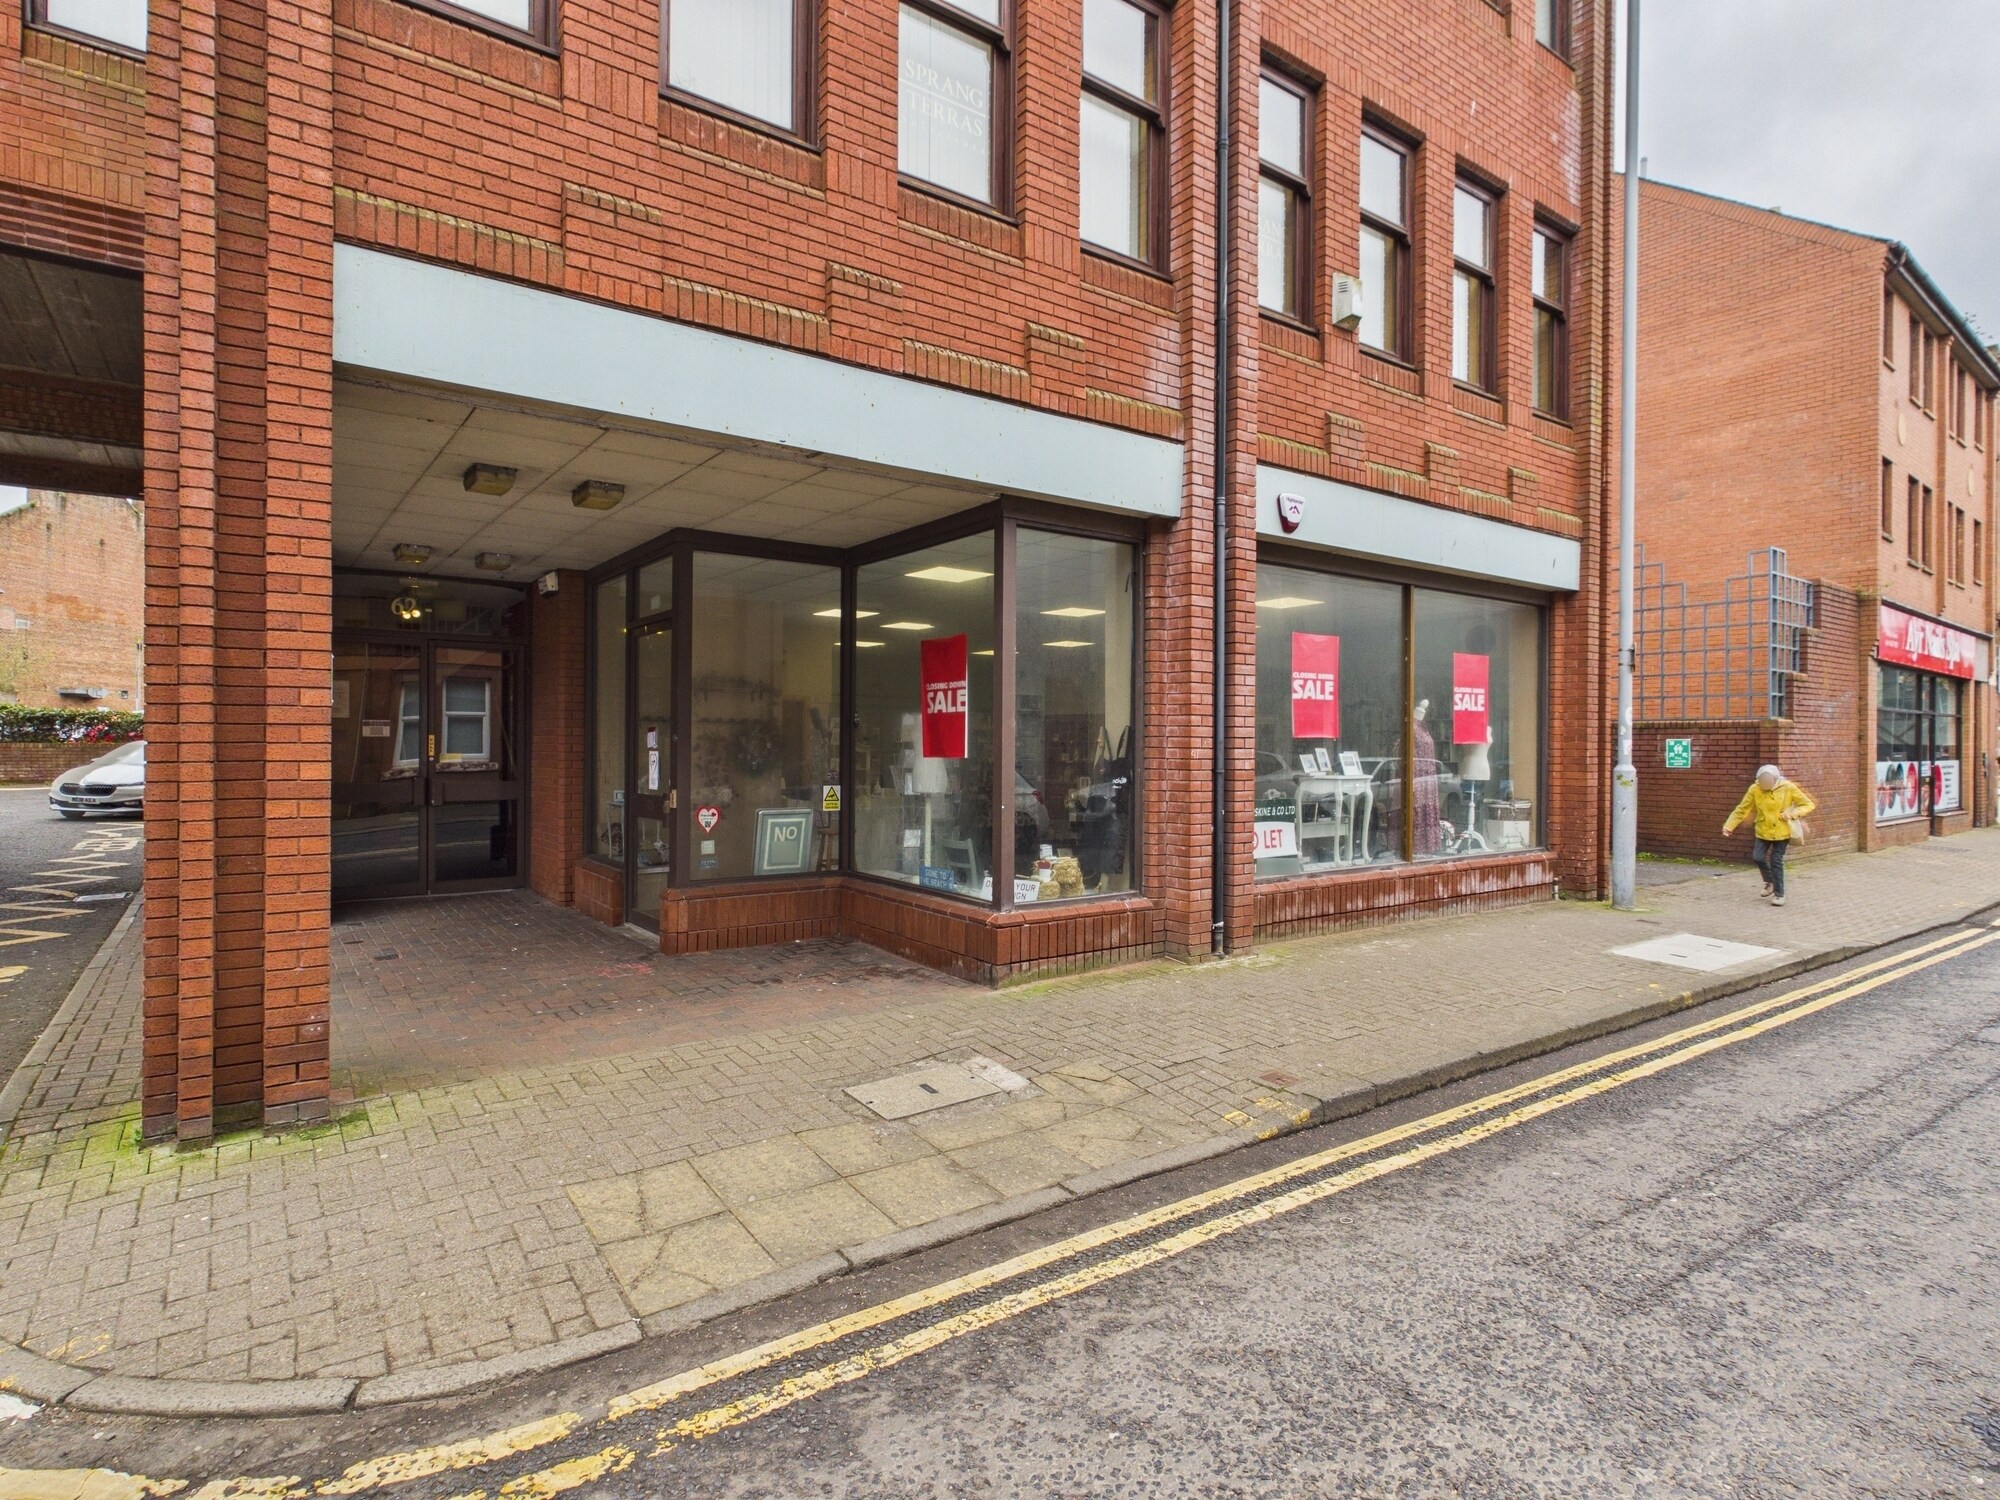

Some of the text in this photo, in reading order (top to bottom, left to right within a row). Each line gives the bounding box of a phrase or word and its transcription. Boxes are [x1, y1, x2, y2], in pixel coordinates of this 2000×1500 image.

[905, 58, 983, 109] SPRANG
[906, 87, 982, 137] TERRAS
[1905, 618, 1923, 662] Ayr
[1923, 622, 1946, 660] Nails
[1292, 671, 1317, 679] CLOSING
[926, 680, 966, 690] CLOSING DOWN
[1292, 680, 1334, 700] SALE
[927, 690, 966, 714] SALE
[1454, 693, 1485, 711] SALE
[1271, 806, 1276, 816] &
[1276, 806, 1284, 816] CO
[1285, 805, 1296, 815] LTD
[774, 826, 798, 842] NO
[1264, 829, 1283, 849] LET
[1016, 883, 1036, 892] YOUR
